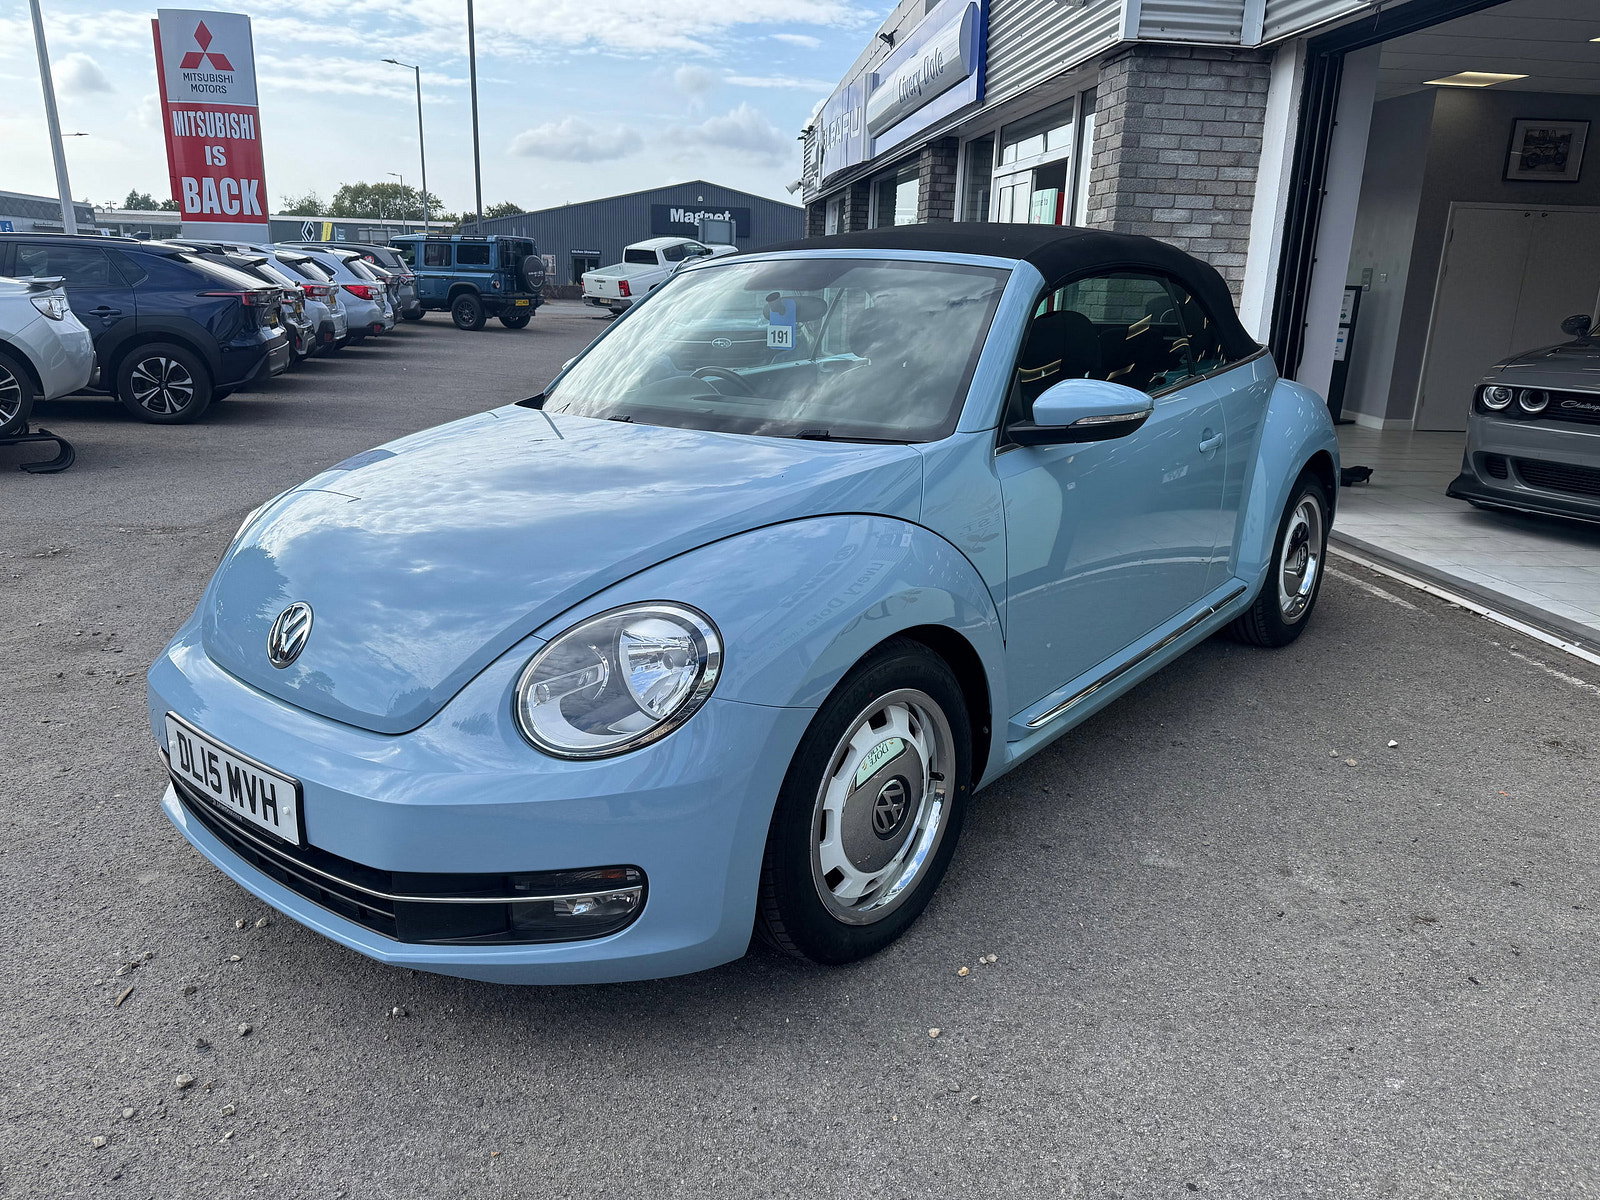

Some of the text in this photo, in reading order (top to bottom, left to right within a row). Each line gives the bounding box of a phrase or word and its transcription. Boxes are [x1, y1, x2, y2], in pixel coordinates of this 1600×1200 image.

[183, 72, 234, 84] MITSUBISHI
[899, 47, 944, 104] Livery Dole
[191, 83, 227, 94] MOTORS
[172, 110, 256, 140] MITSUBISHI
[204, 145, 227, 167] IS
[181, 176, 263, 216] BACK
[670, 207, 731, 227] Magnet
[770, 330, 789, 344] 191
[176, 729, 280, 828] DL15 MVH
